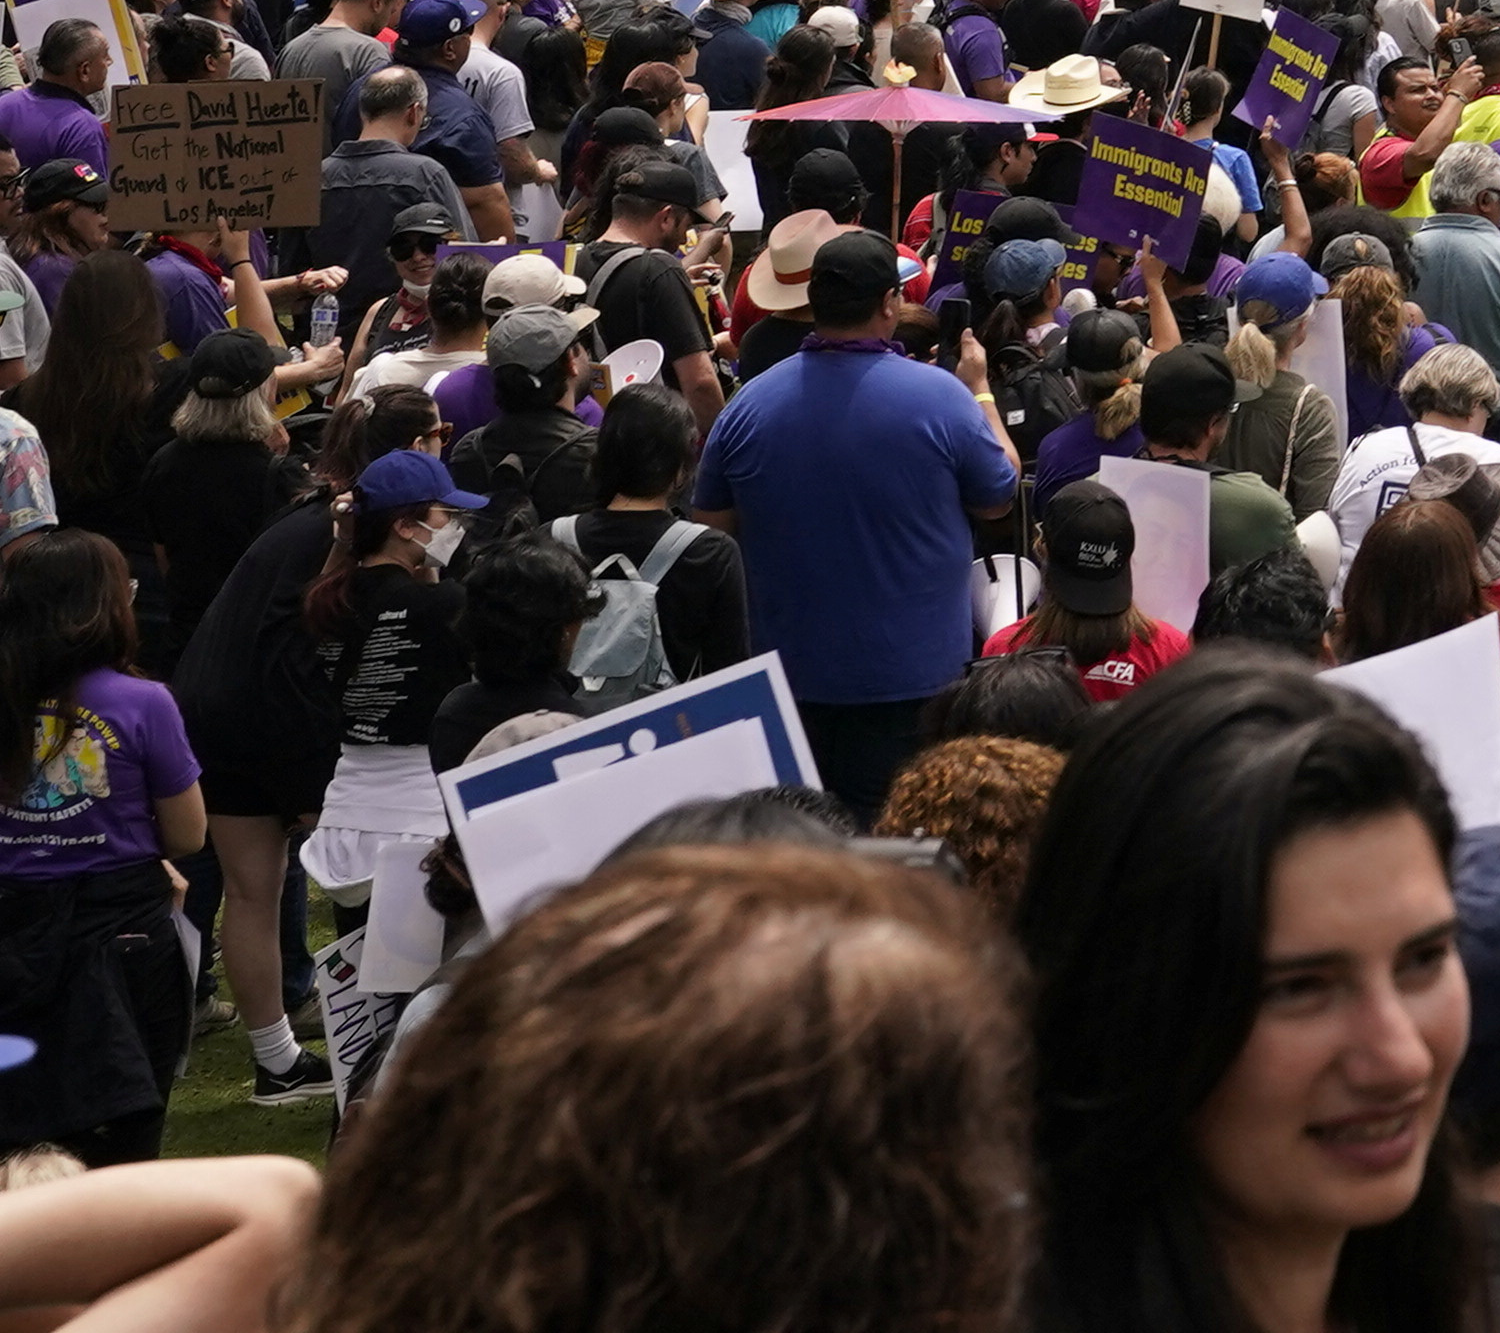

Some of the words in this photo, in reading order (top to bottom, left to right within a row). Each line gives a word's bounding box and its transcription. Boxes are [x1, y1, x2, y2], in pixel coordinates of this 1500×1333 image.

[1267, 27, 1316, 77] Immigrants
[1312, 52, 1329, 81] Are
[1268, 66, 1310, 104] Essential
[115, 86, 176, 124] Free
[187, 91, 237, 120] David
[244, 83, 323, 123] Huerta!
[132, 133, 172, 160] Get
[184, 137, 210, 159] the
[215, 130, 284, 161] National
[109, 165, 167, 197] Guard
[198, 165, 235, 191] ICE
[240, 169, 273, 184] out
[1091, 135, 1182, 182] Immigrants
[1181, 166, 1206, 197] Are
[163, 199, 199, 223] Los
[1113, 173, 1184, 219] Essential
[950, 211, 985, 235] Los
[1359, 459, 1399, 488] Action
[1103, 660, 1135, 681] CFA
[90, 715, 120, 750] POWER
[7, 808, 48, 822] PATIENT
